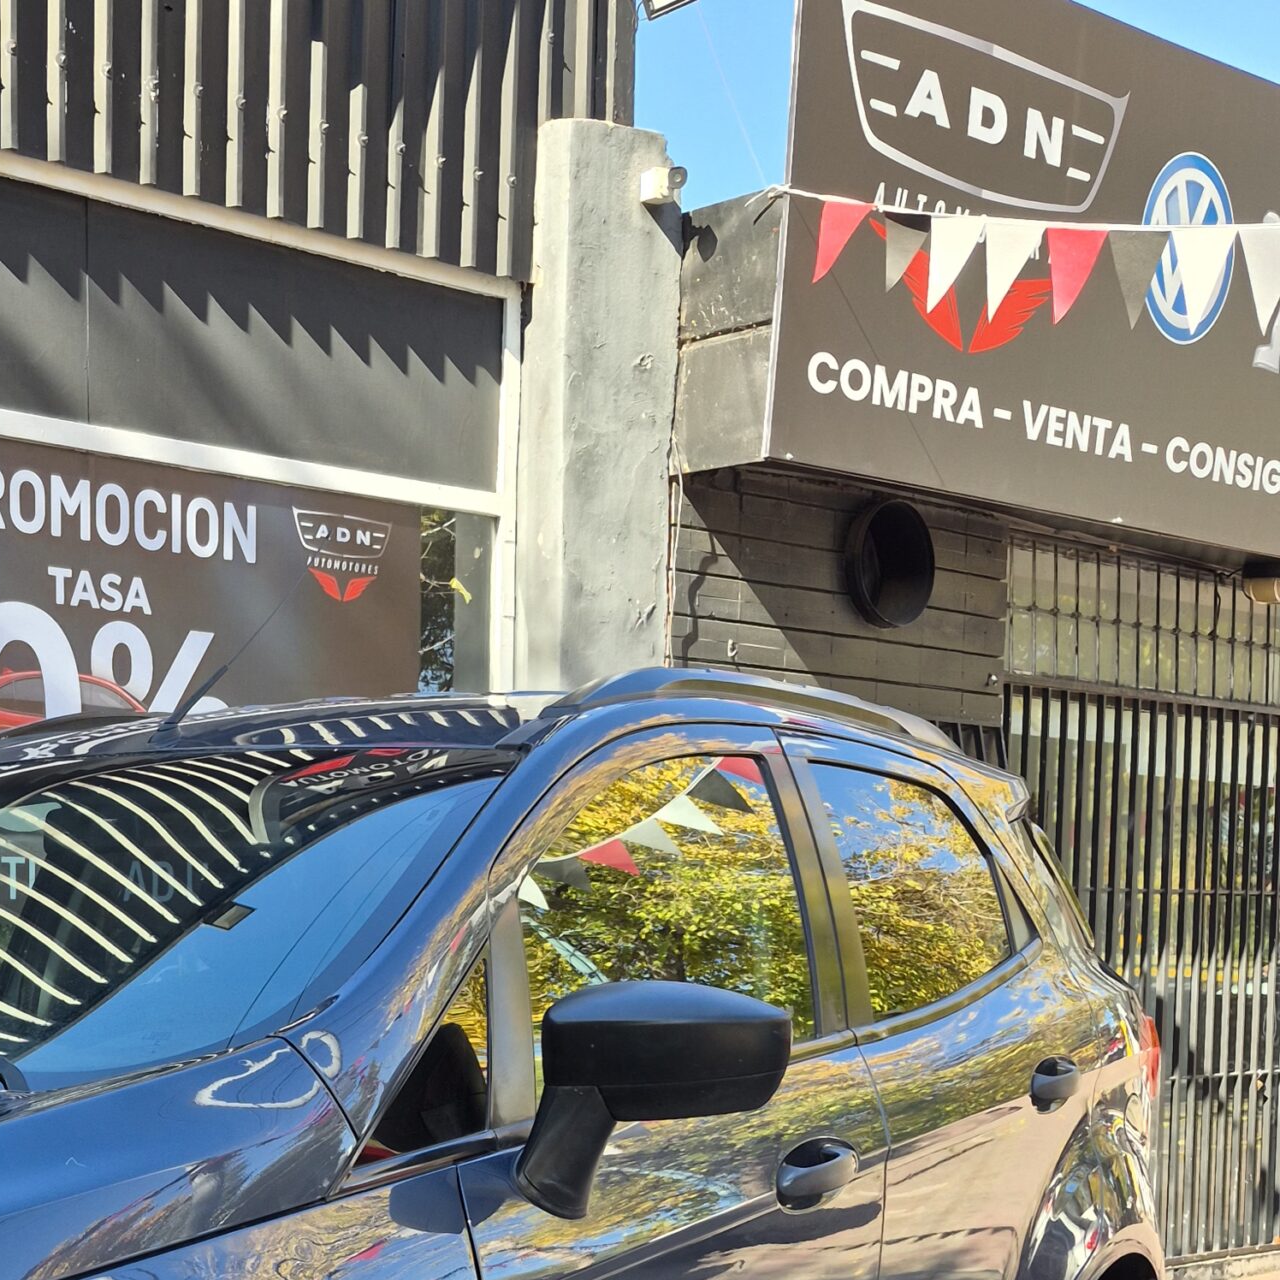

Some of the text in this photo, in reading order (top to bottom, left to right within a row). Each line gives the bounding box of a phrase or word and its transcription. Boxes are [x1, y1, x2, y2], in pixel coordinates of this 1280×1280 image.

[904, 69, 1066, 168] ADN
[807, 351, 984, 428] COMPRA
[1023, 400, 1132, 462] VENTA
[1165, 436, 1280, 494] CONSIG
[315, 524, 371, 546] ADN
[48, 566, 152, 615] TASA
